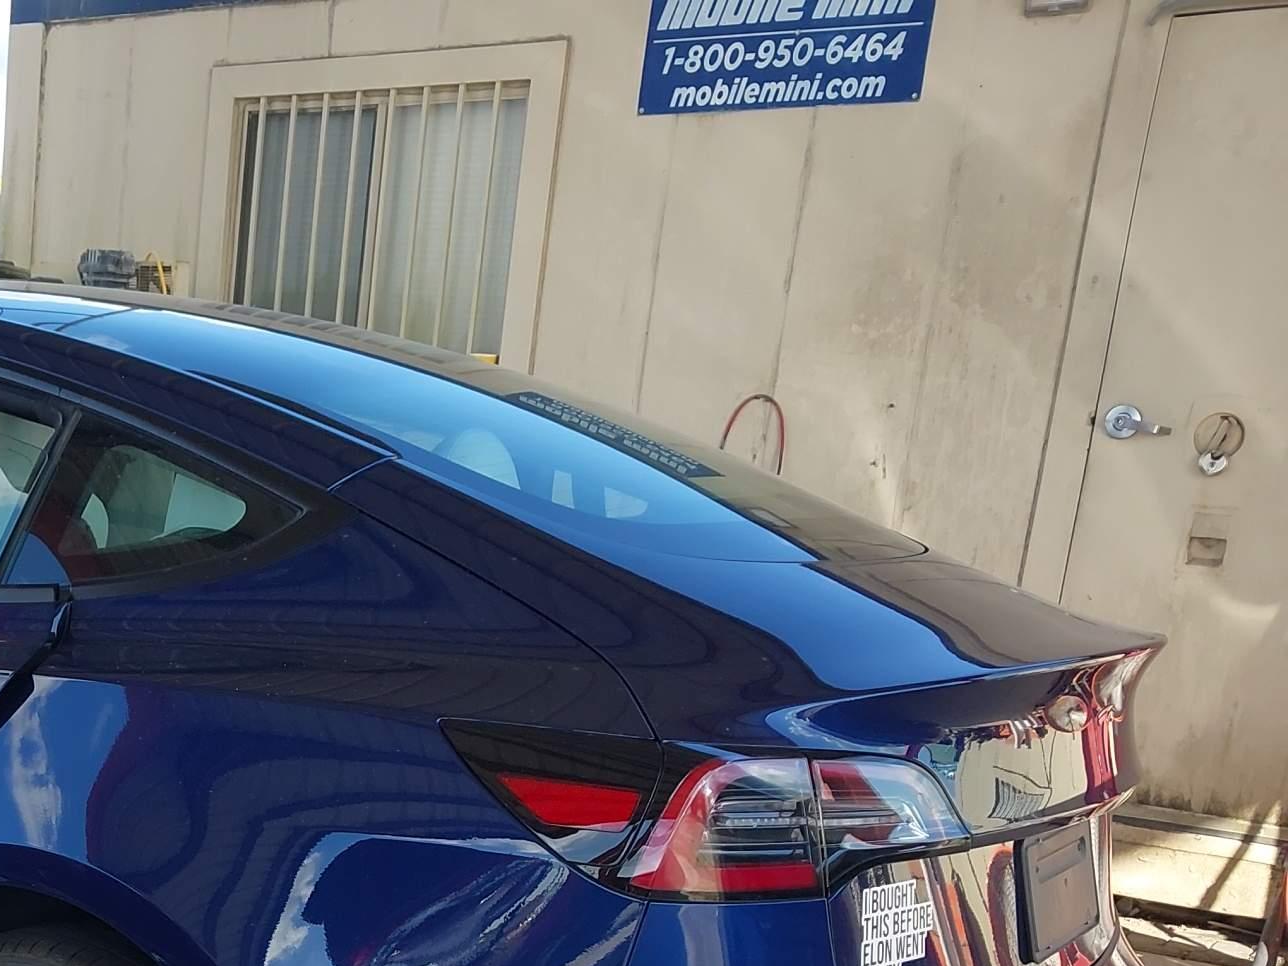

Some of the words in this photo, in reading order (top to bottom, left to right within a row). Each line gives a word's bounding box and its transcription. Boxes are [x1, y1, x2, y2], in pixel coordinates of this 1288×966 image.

[662, 31, 907, 75] 1-800-950-6464
[669, 72, 886, 108] mobilemini.com
[872, 882, 915, 914] BOUGHT
[864, 913, 890, 941] THIS
[893, 904, 932, 936] BEFORE
[896, 931, 925, 961] WENT
